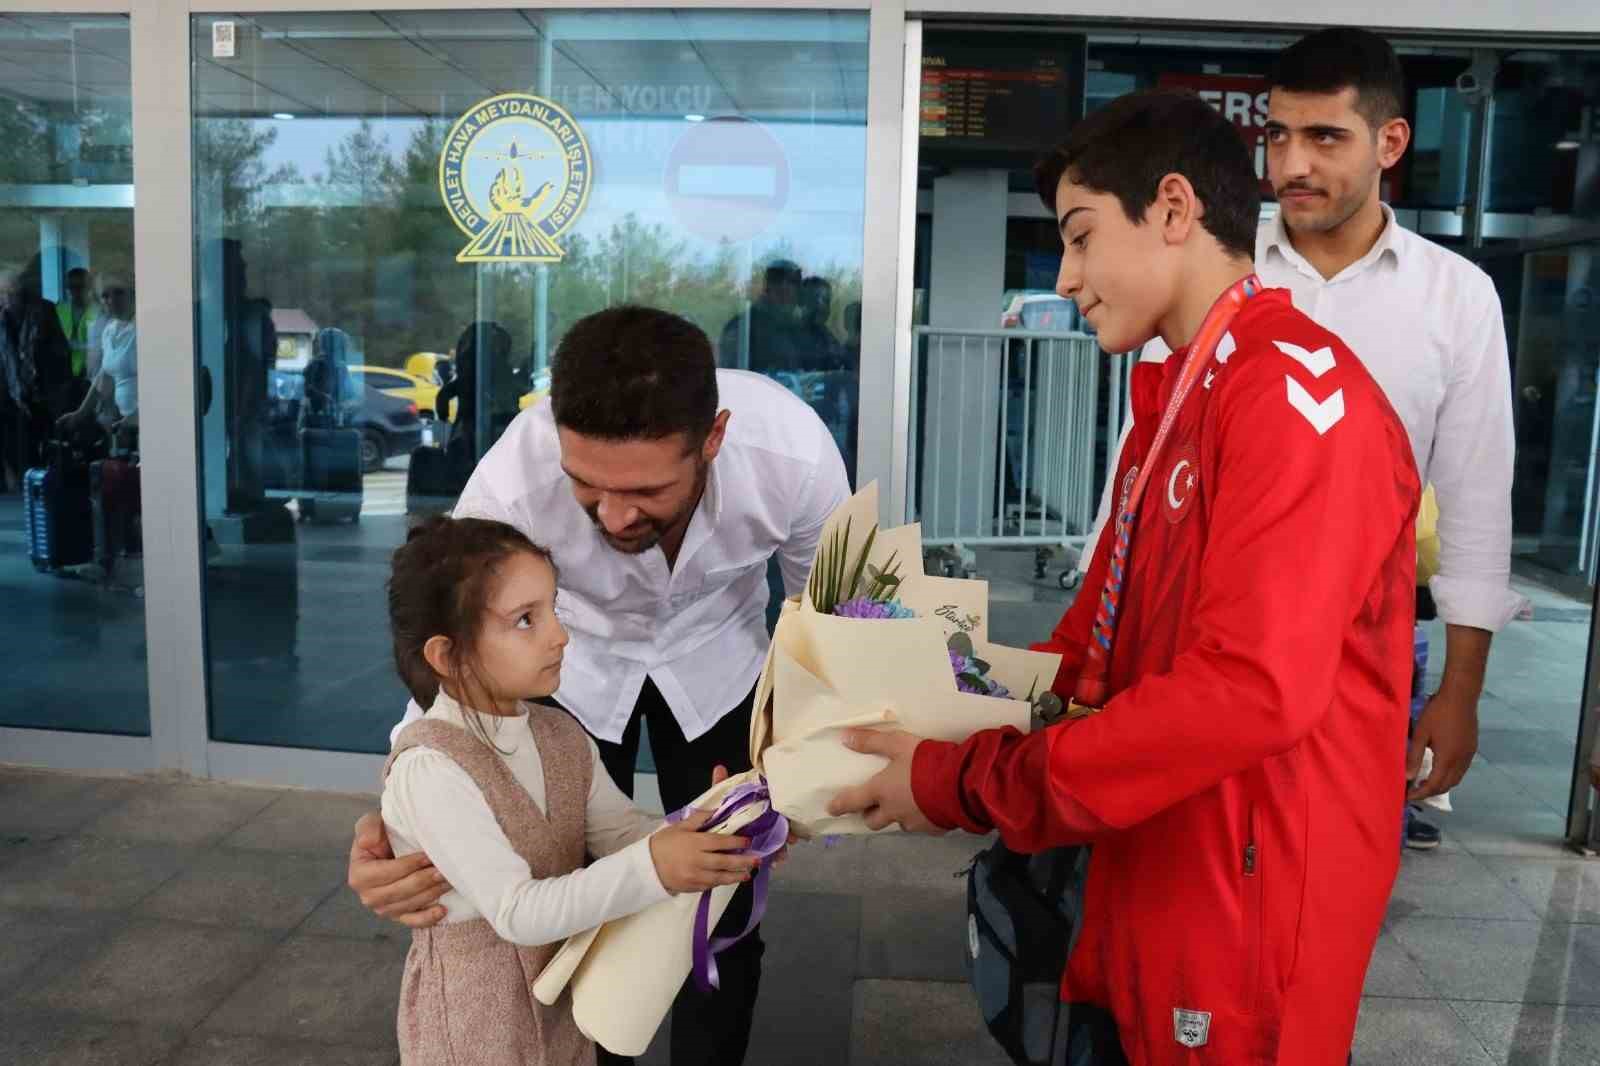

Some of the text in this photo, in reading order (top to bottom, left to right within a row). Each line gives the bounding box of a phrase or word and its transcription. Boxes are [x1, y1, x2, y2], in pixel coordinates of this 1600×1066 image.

[447, 120, 478, 162] HAVA
[475, 101, 575, 143] MEYDANLARI
[446, 167, 480, 229] DEVLET
